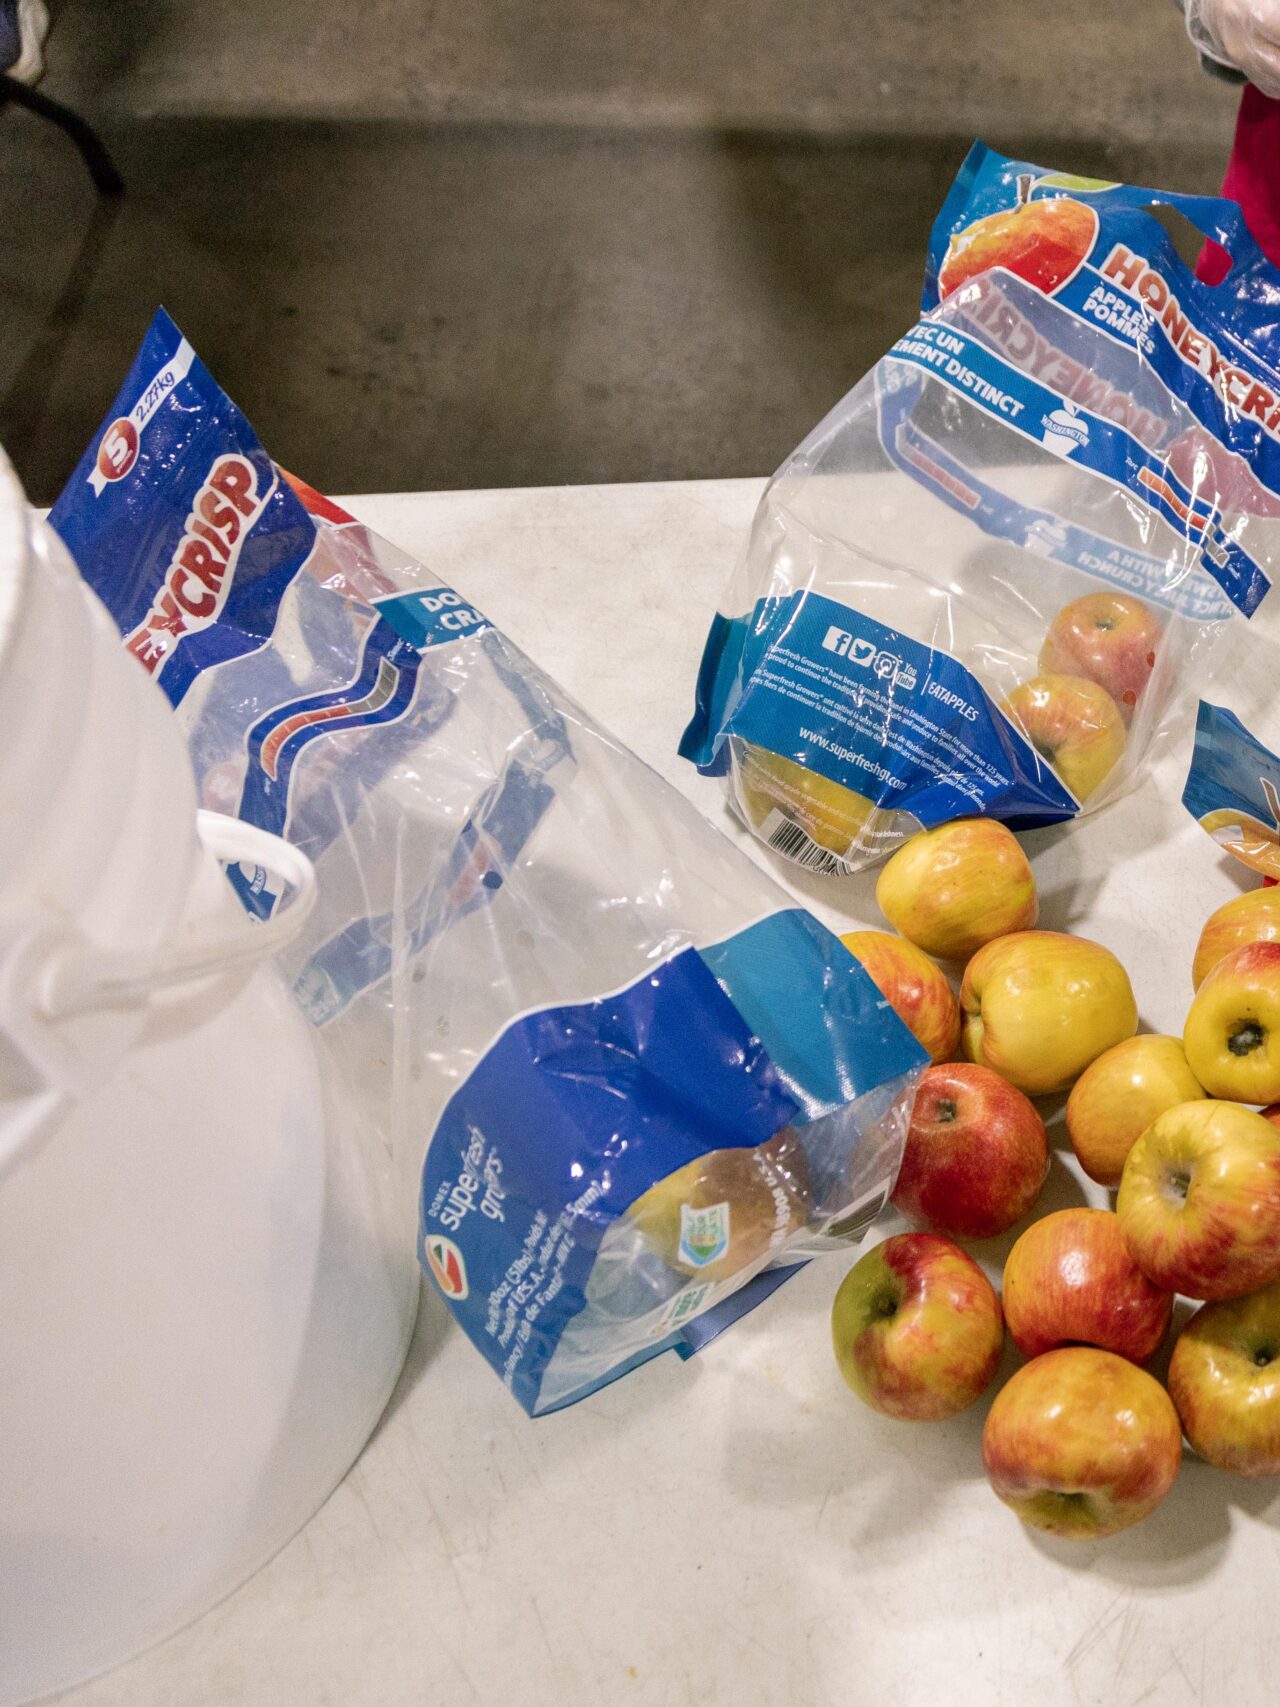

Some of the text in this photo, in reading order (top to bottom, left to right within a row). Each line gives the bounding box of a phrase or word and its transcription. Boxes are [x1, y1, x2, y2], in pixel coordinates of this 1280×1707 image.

[1090, 286, 1155, 329] APPLES
[936, 331, 965, 355] UN
[1083, 301, 1156, 354] POMMES
[945, 359, 1025, 417] DISTINCT
[103, 428, 128, 465] 5
[135, 370, 174, 421] 2.27kg
[1042, 414, 1090, 447] WASHINGTON
[761, 668, 796, 688] Superfresh
[822, 697, 833, 706] ont
[903, 663, 917, 675] You
[777, 685, 786, 693] de
[786, 689, 815, 707] continuer
[815, 702, 822, 710] la
[821, 706, 847, 722] tradition
[794, 663, 821, 679] continue
[821, 675, 832, 684] the
[956, 751, 965, 760] all
[963, 758, 976, 769] over
[958, 744, 973, 756] more
[973, 754, 986, 766] than
[986, 763, 996, 774] 125
[427, 1179, 451, 1217] DOMEX
